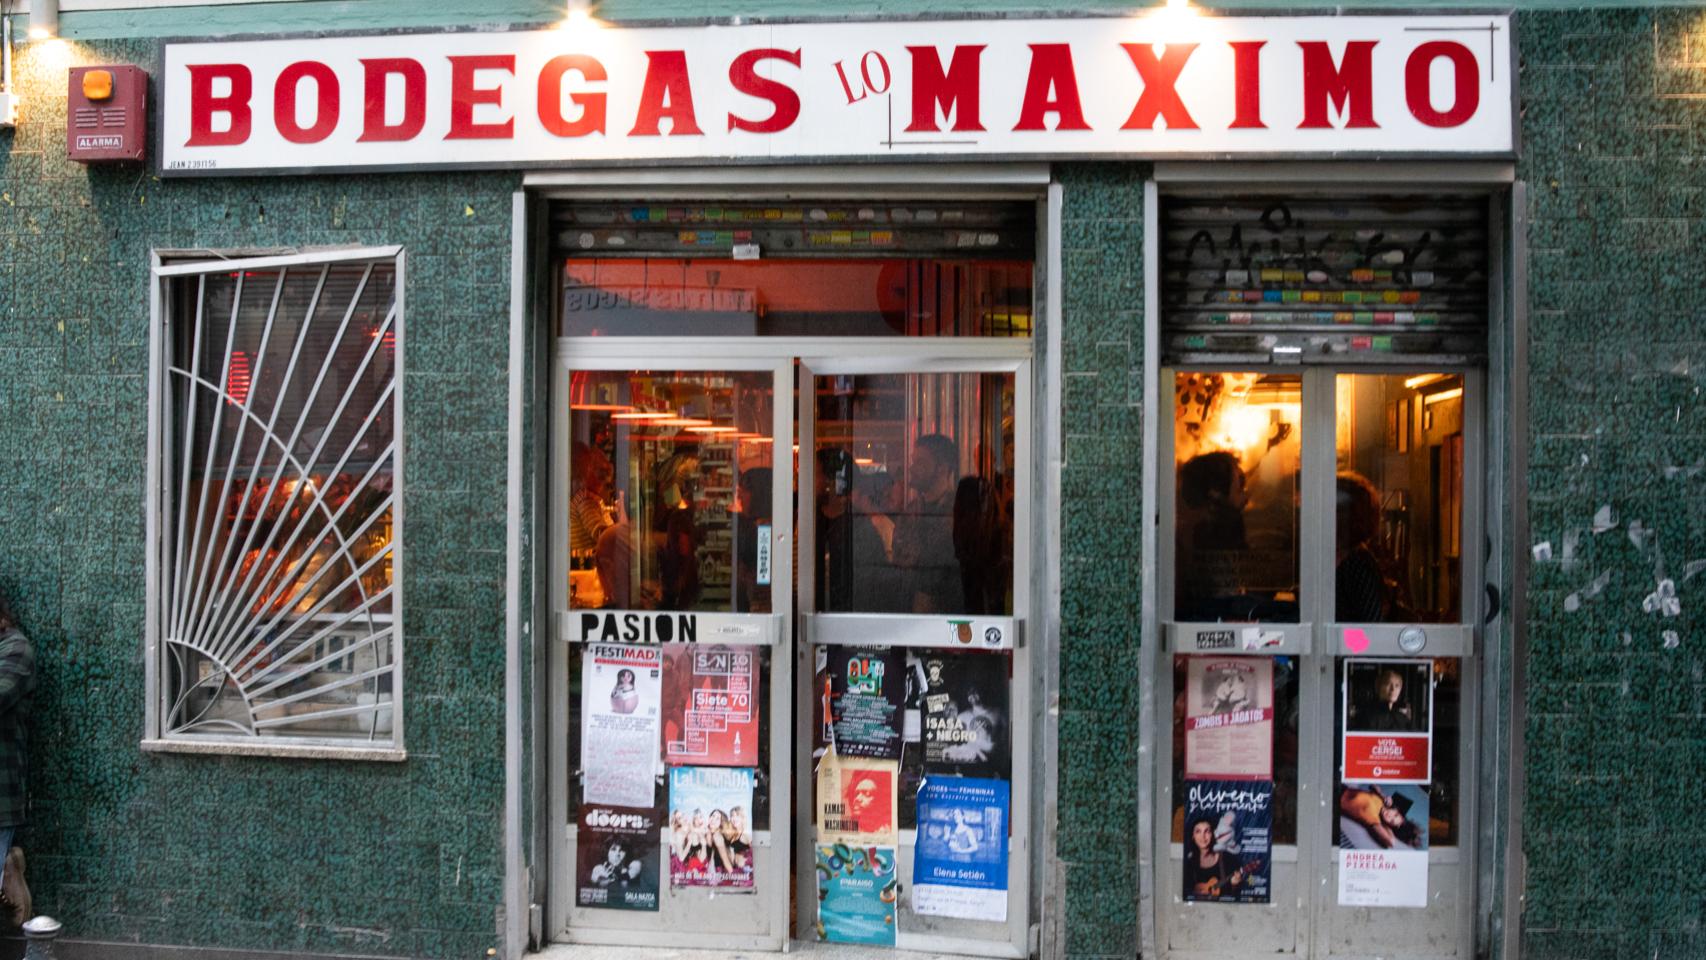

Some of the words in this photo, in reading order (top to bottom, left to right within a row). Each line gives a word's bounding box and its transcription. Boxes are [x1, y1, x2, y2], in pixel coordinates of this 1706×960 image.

[831, 49, 892, 106] LO
[903, 39, 1481, 132] MAXIMO
[184, 48, 802, 147] BODEGAS
[79, 137, 119, 147] ALARMA
[168, 160, 185, 169] JEAN
[581, 612, 697, 643] PASION
[595, 646, 655, 660] FESTIMAD
[731, 655, 749, 666] 10
[696, 692, 728, 706] Siete
[731, 693, 748, 706] 70
[926, 717, 964, 730] ISASA
[926, 731, 934, 741] +
[936, 729, 977, 742] NEGRO
[1377, 738, 1397, 747] VOTA
[927, 784, 948, 793] VOCES
[959, 786, 995, 797] FEMENINAS
[824, 802, 846, 815] KAMASI
[585, 808, 643, 829] doors
[824, 819, 859, 831] WASHINGTON
[1346, 853, 1385, 861] ANDREA
[933, 866, 957, 878] Elena
[1346, 861, 1398, 870] PIXELADA
